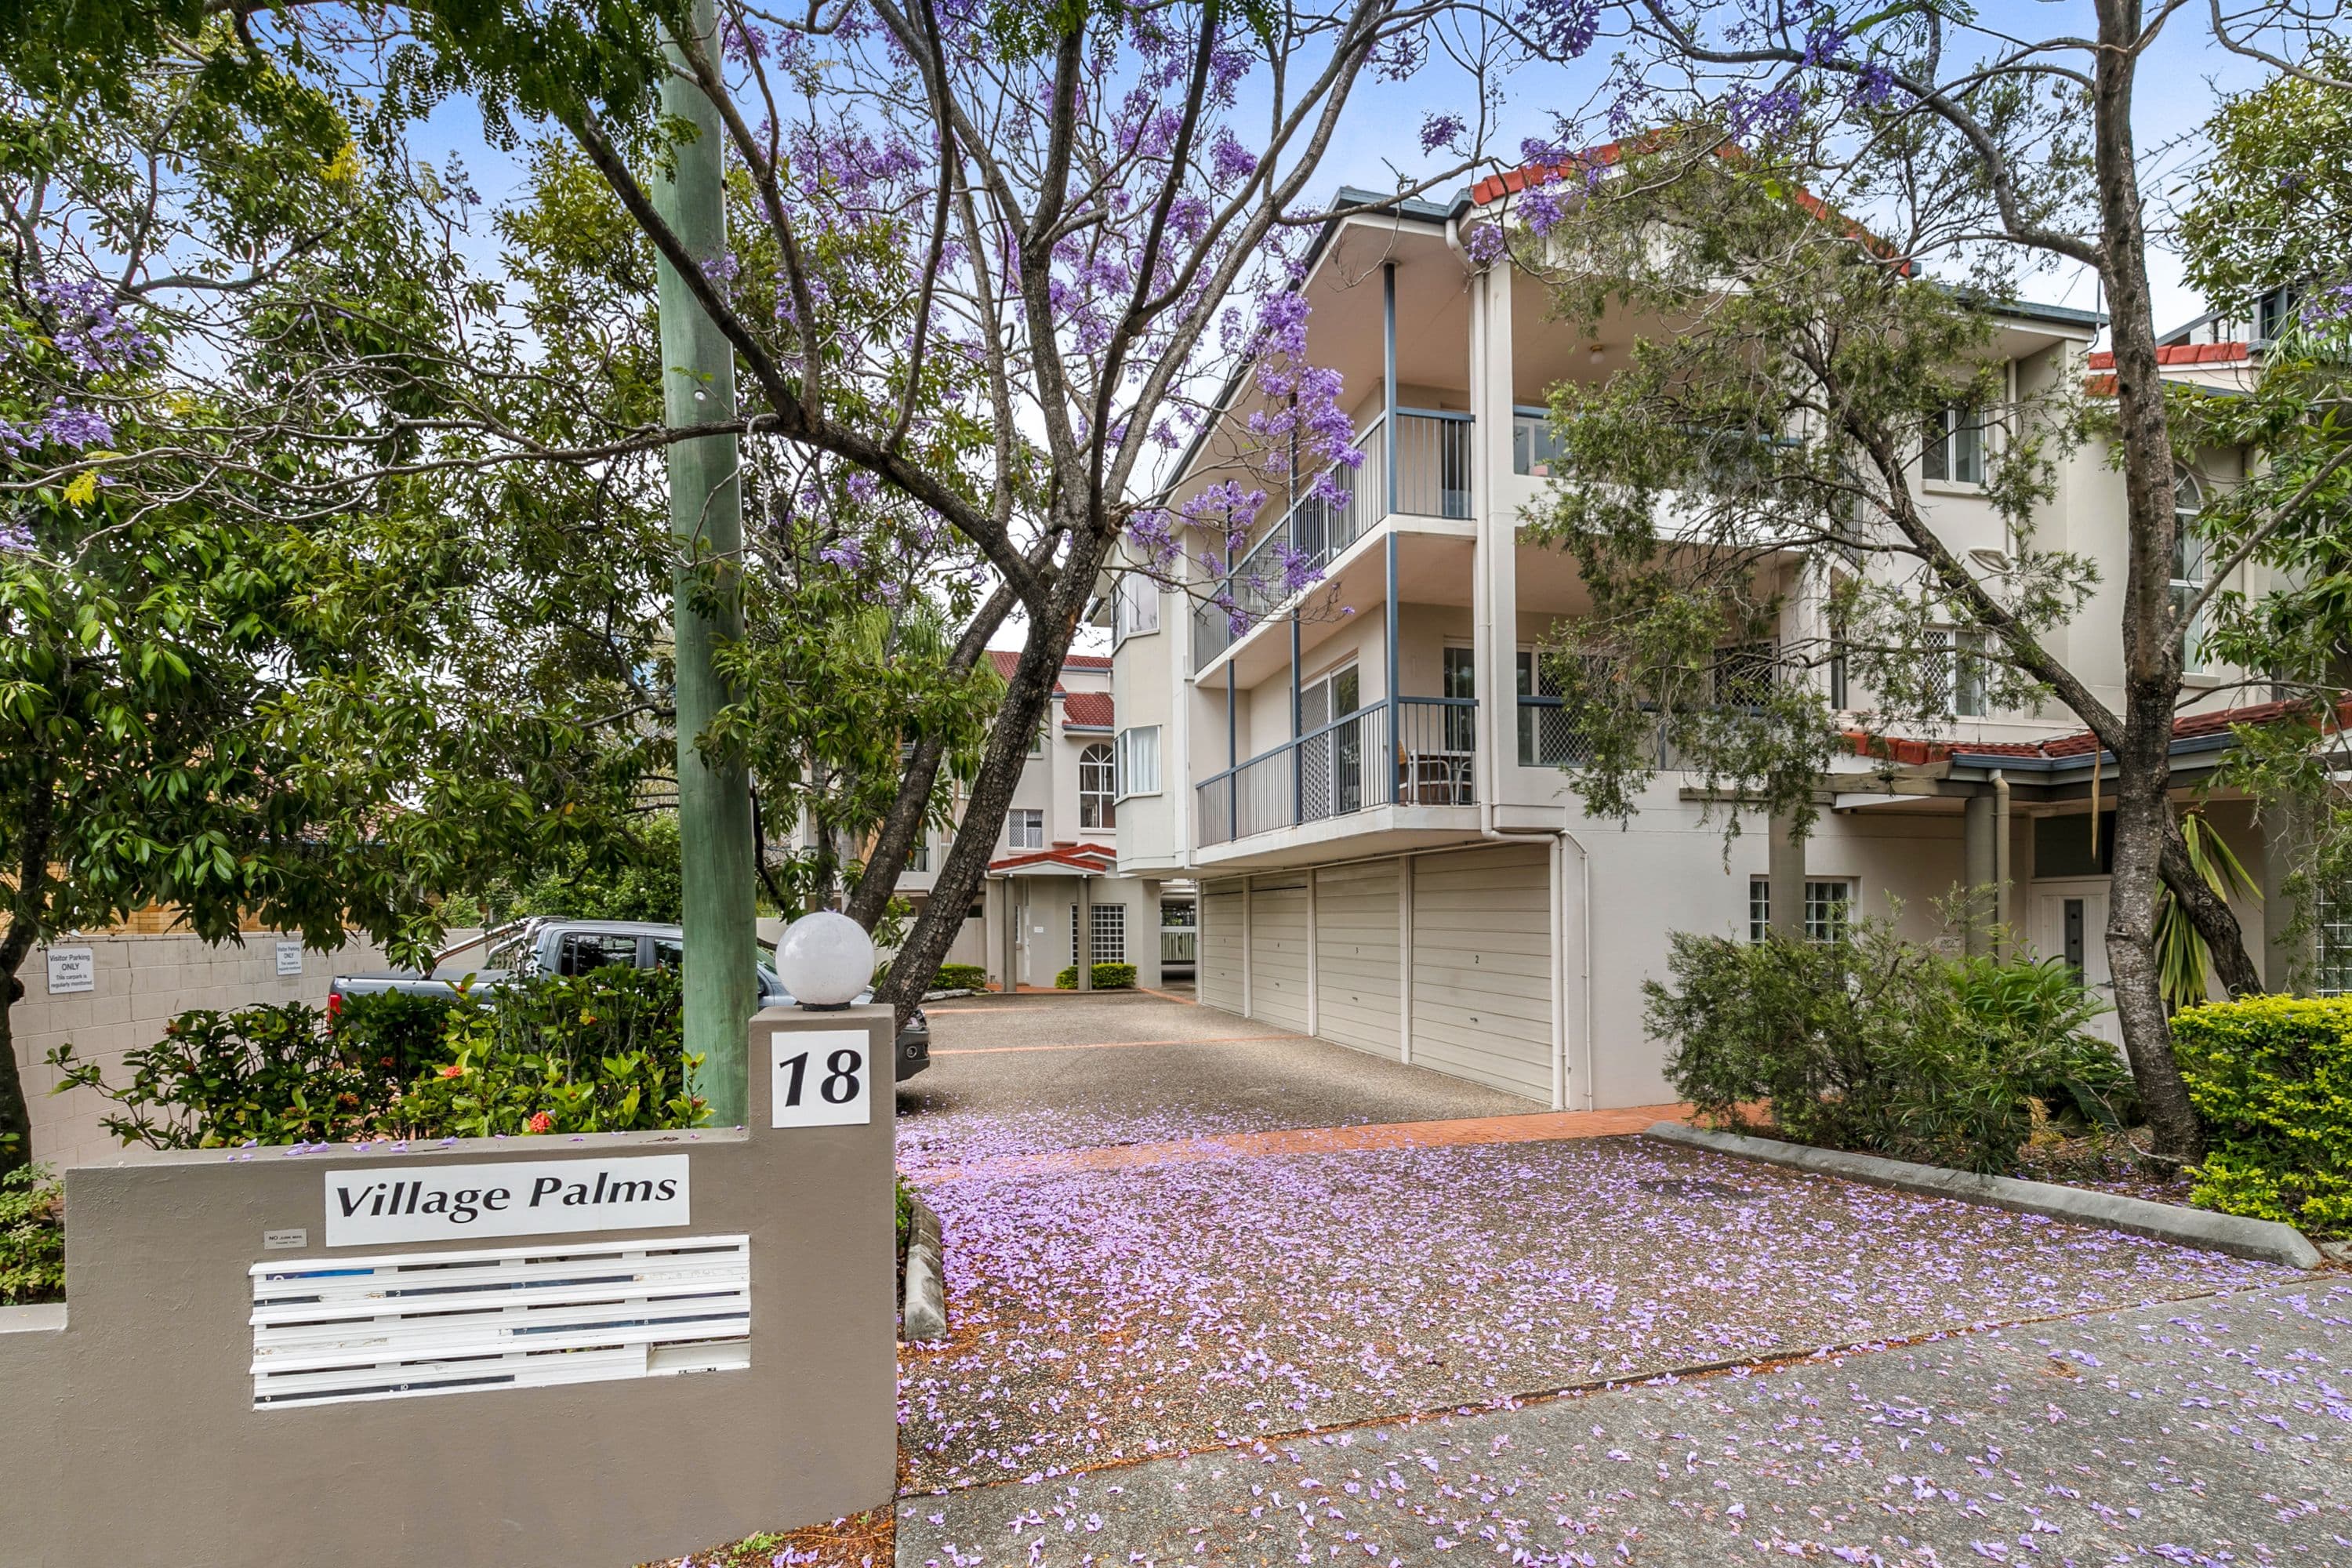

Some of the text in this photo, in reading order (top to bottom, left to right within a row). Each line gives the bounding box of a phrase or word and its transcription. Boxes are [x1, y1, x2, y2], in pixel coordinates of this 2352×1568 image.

[1475, 954, 1480, 964] 2
[779, 1049, 862, 1107] 18
[336, 1172, 677, 1224] Village Palms
